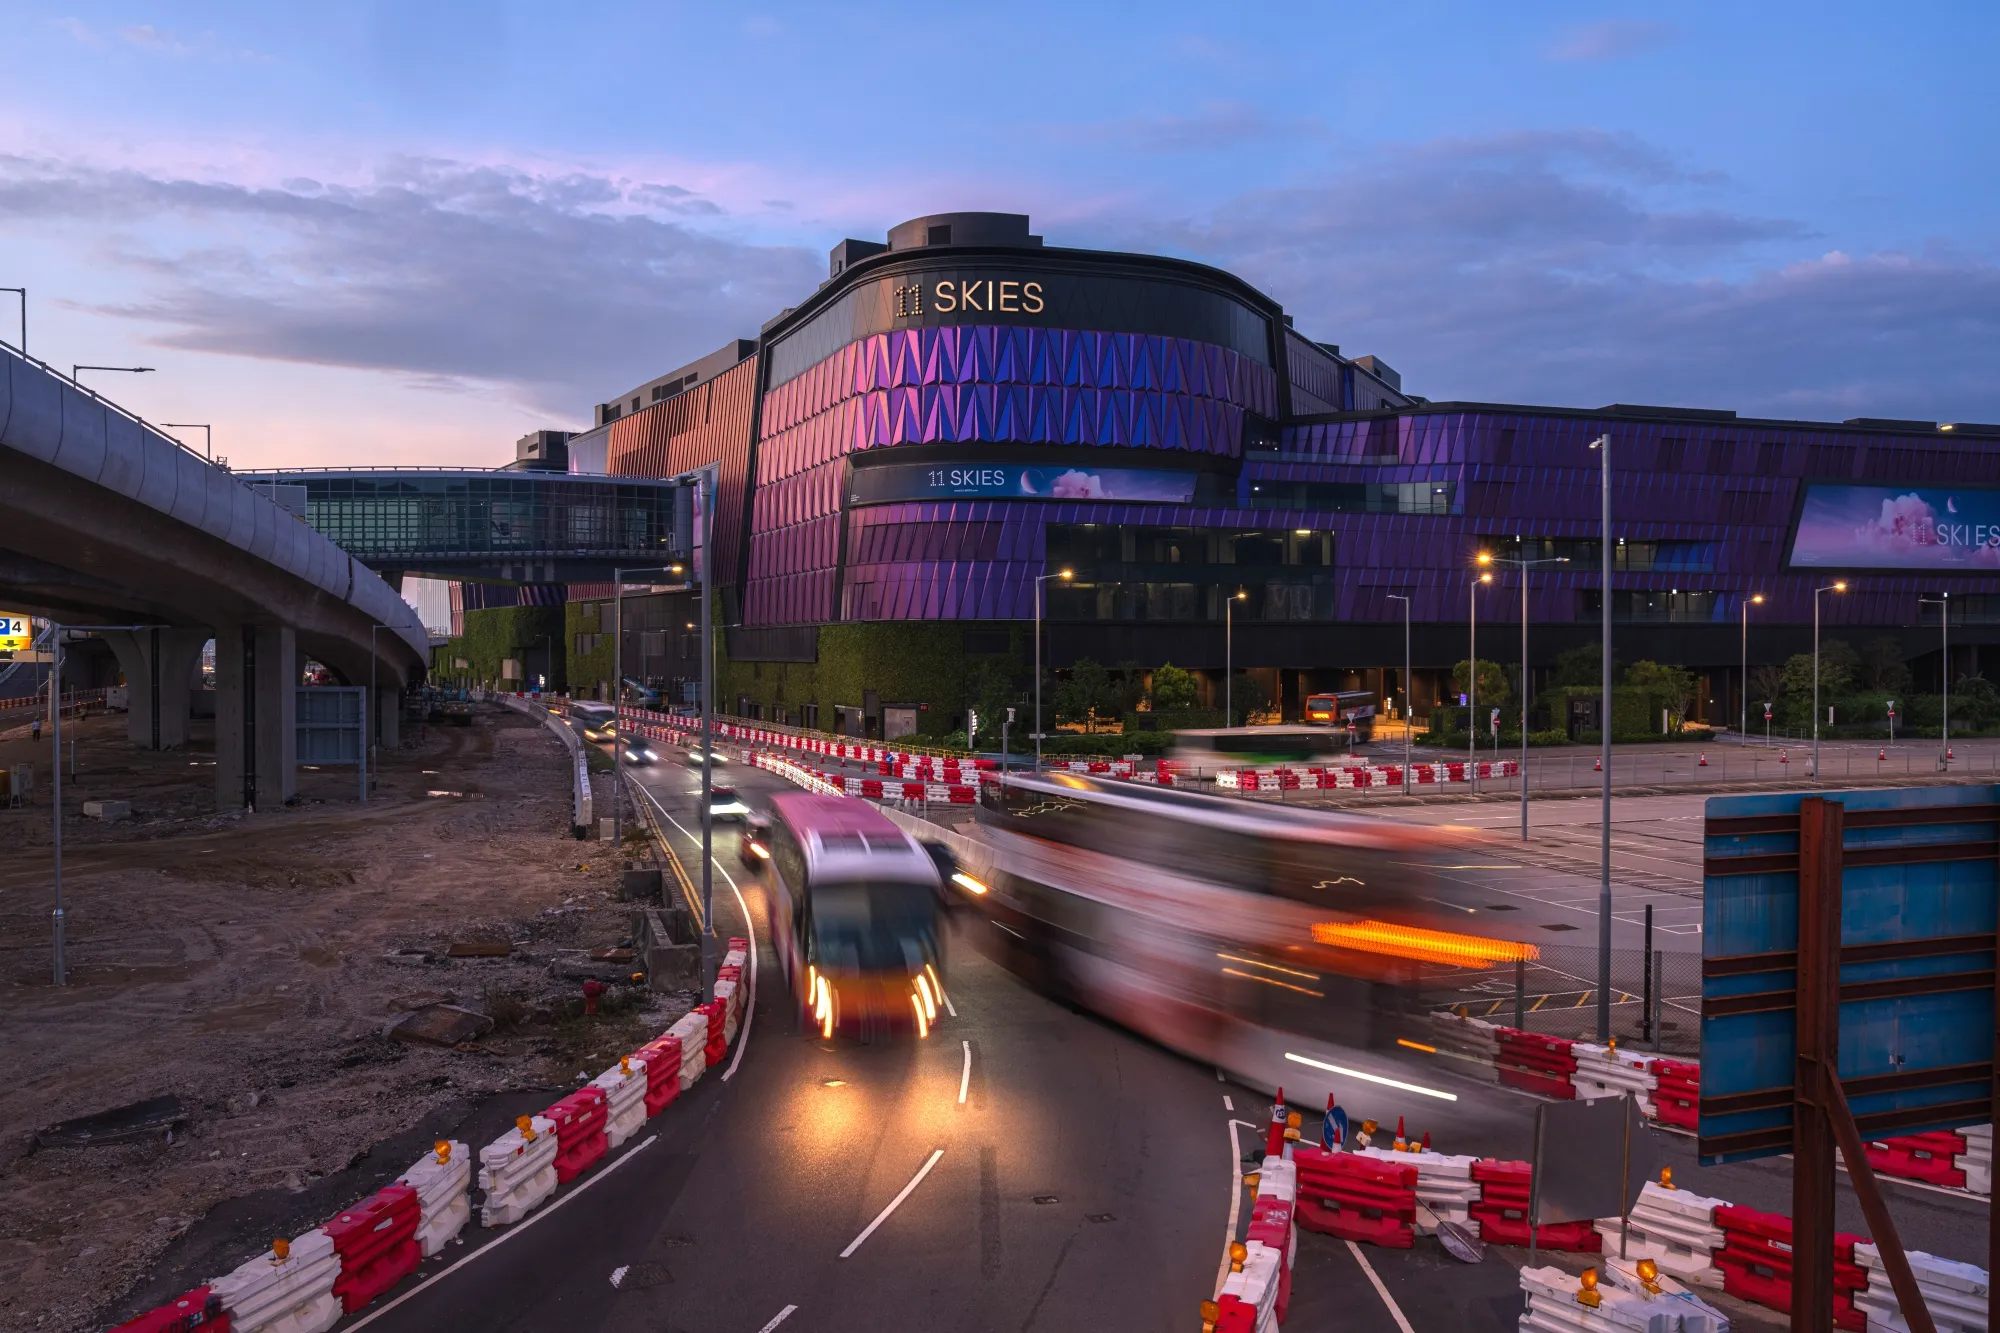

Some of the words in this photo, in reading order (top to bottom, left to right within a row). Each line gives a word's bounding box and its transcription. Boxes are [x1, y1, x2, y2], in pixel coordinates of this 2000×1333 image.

[894, 284, 924, 317] 11
[934, 280, 1045, 314] SKIES
[928, 470, 945, 487] 11
[950, 470, 1005, 486] SKIES
[1909, 523, 1928, 545] 11
[1936, 523, 2000, 547] SKIES
[12, 621, 22, 633] 4
